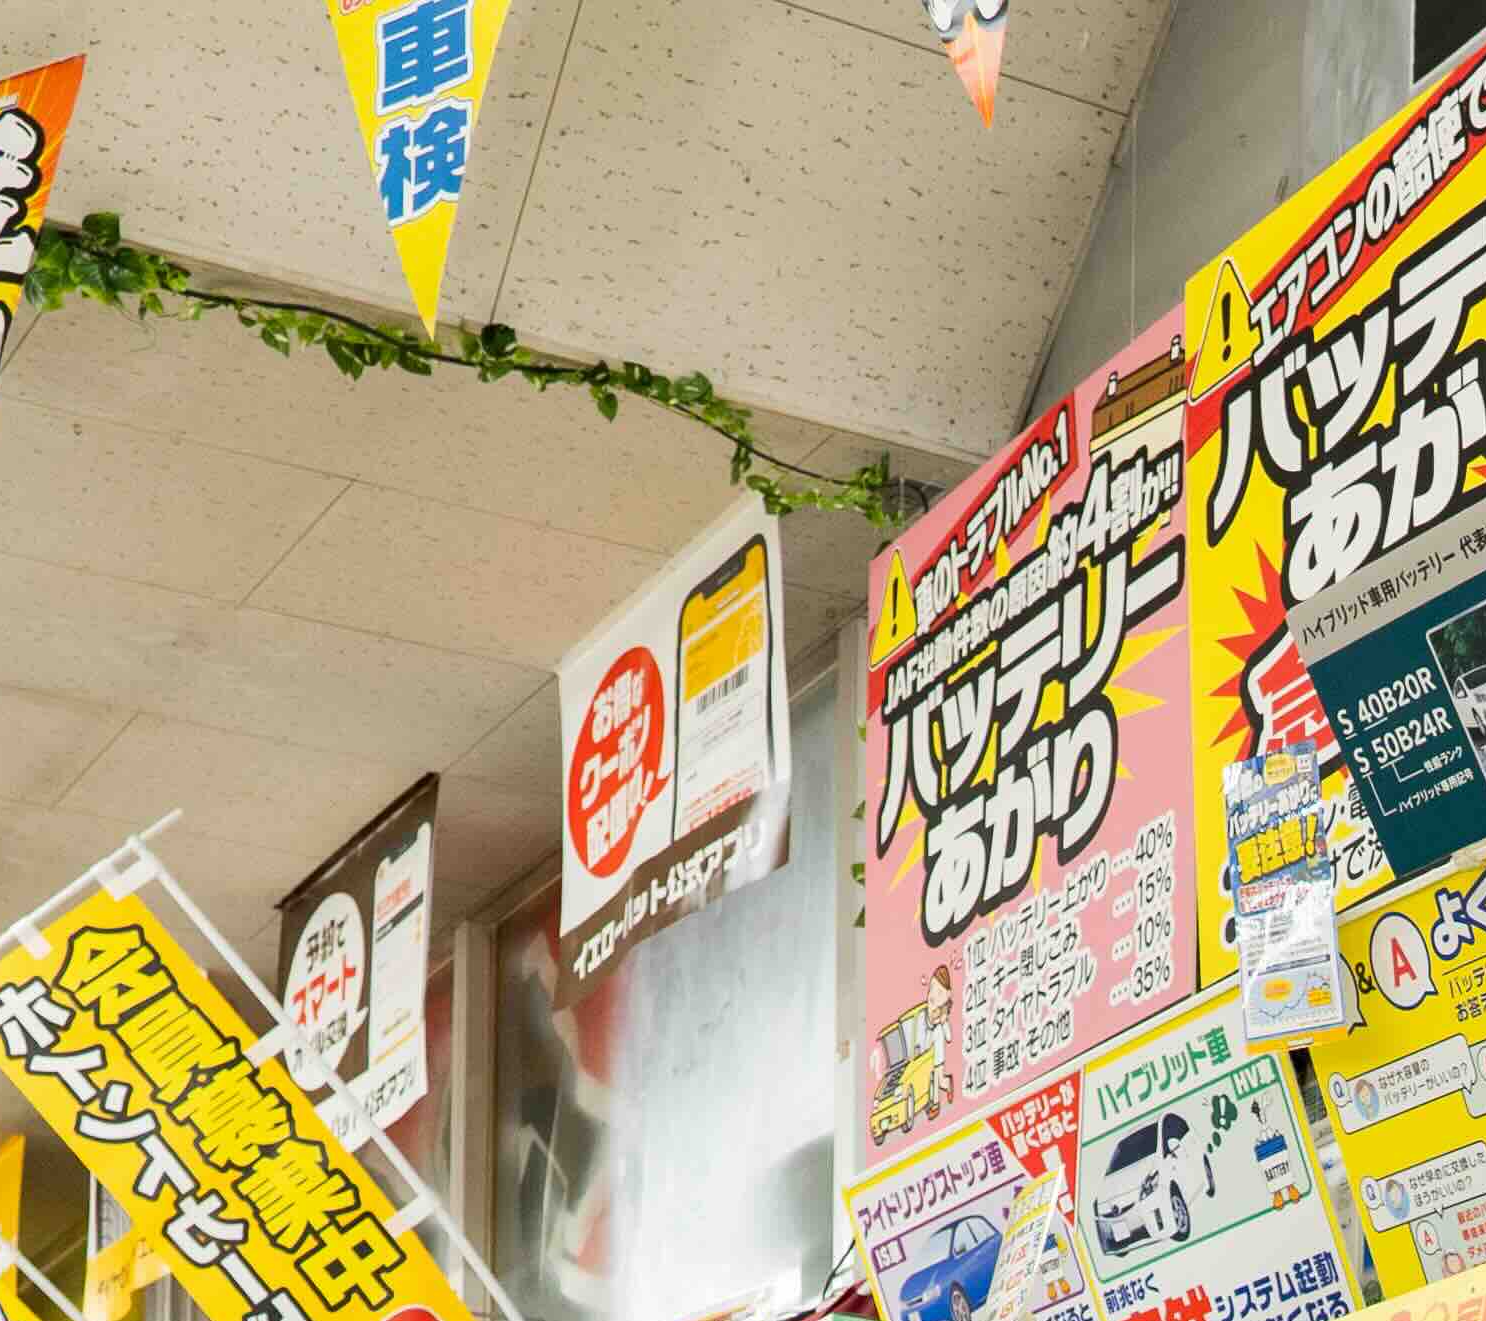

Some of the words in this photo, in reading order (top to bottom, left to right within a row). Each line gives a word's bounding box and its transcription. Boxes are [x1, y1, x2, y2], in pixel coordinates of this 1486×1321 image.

[375, 3, 476, 225] 車検
[915, 415, 1070, 636] 車のトラブルNo.1
[878, 536, 1182, 860] バッテリー
[1357, 667, 1438, 724] 40B20R
[1371, 706, 1453, 766] 50B24R
[923, 710, 1117, 948] あがり
[988, 858, 1107, 963] バッテリー上がり
[1135, 820, 1174, 861] 40%
[573, 820, 765, 980] イエローハット公式アプリ
[991, 930, 1080, 995] キー閉じこみ
[1136, 864, 1174, 906] 15%
[991, 952, 1096, 1039] タイヤトラブル
[1132, 915, 1172, 952] 10%
[991, 1018, 1073, 1080] 事故・その他
[1131, 960, 1172, 998] 35%
[1097, 1026, 1232, 1120] ハイブリッド車
[858, 1144, 1007, 1238] アイドリングストップ車
[1104, 1271, 1159, 1314] 前兆なく
